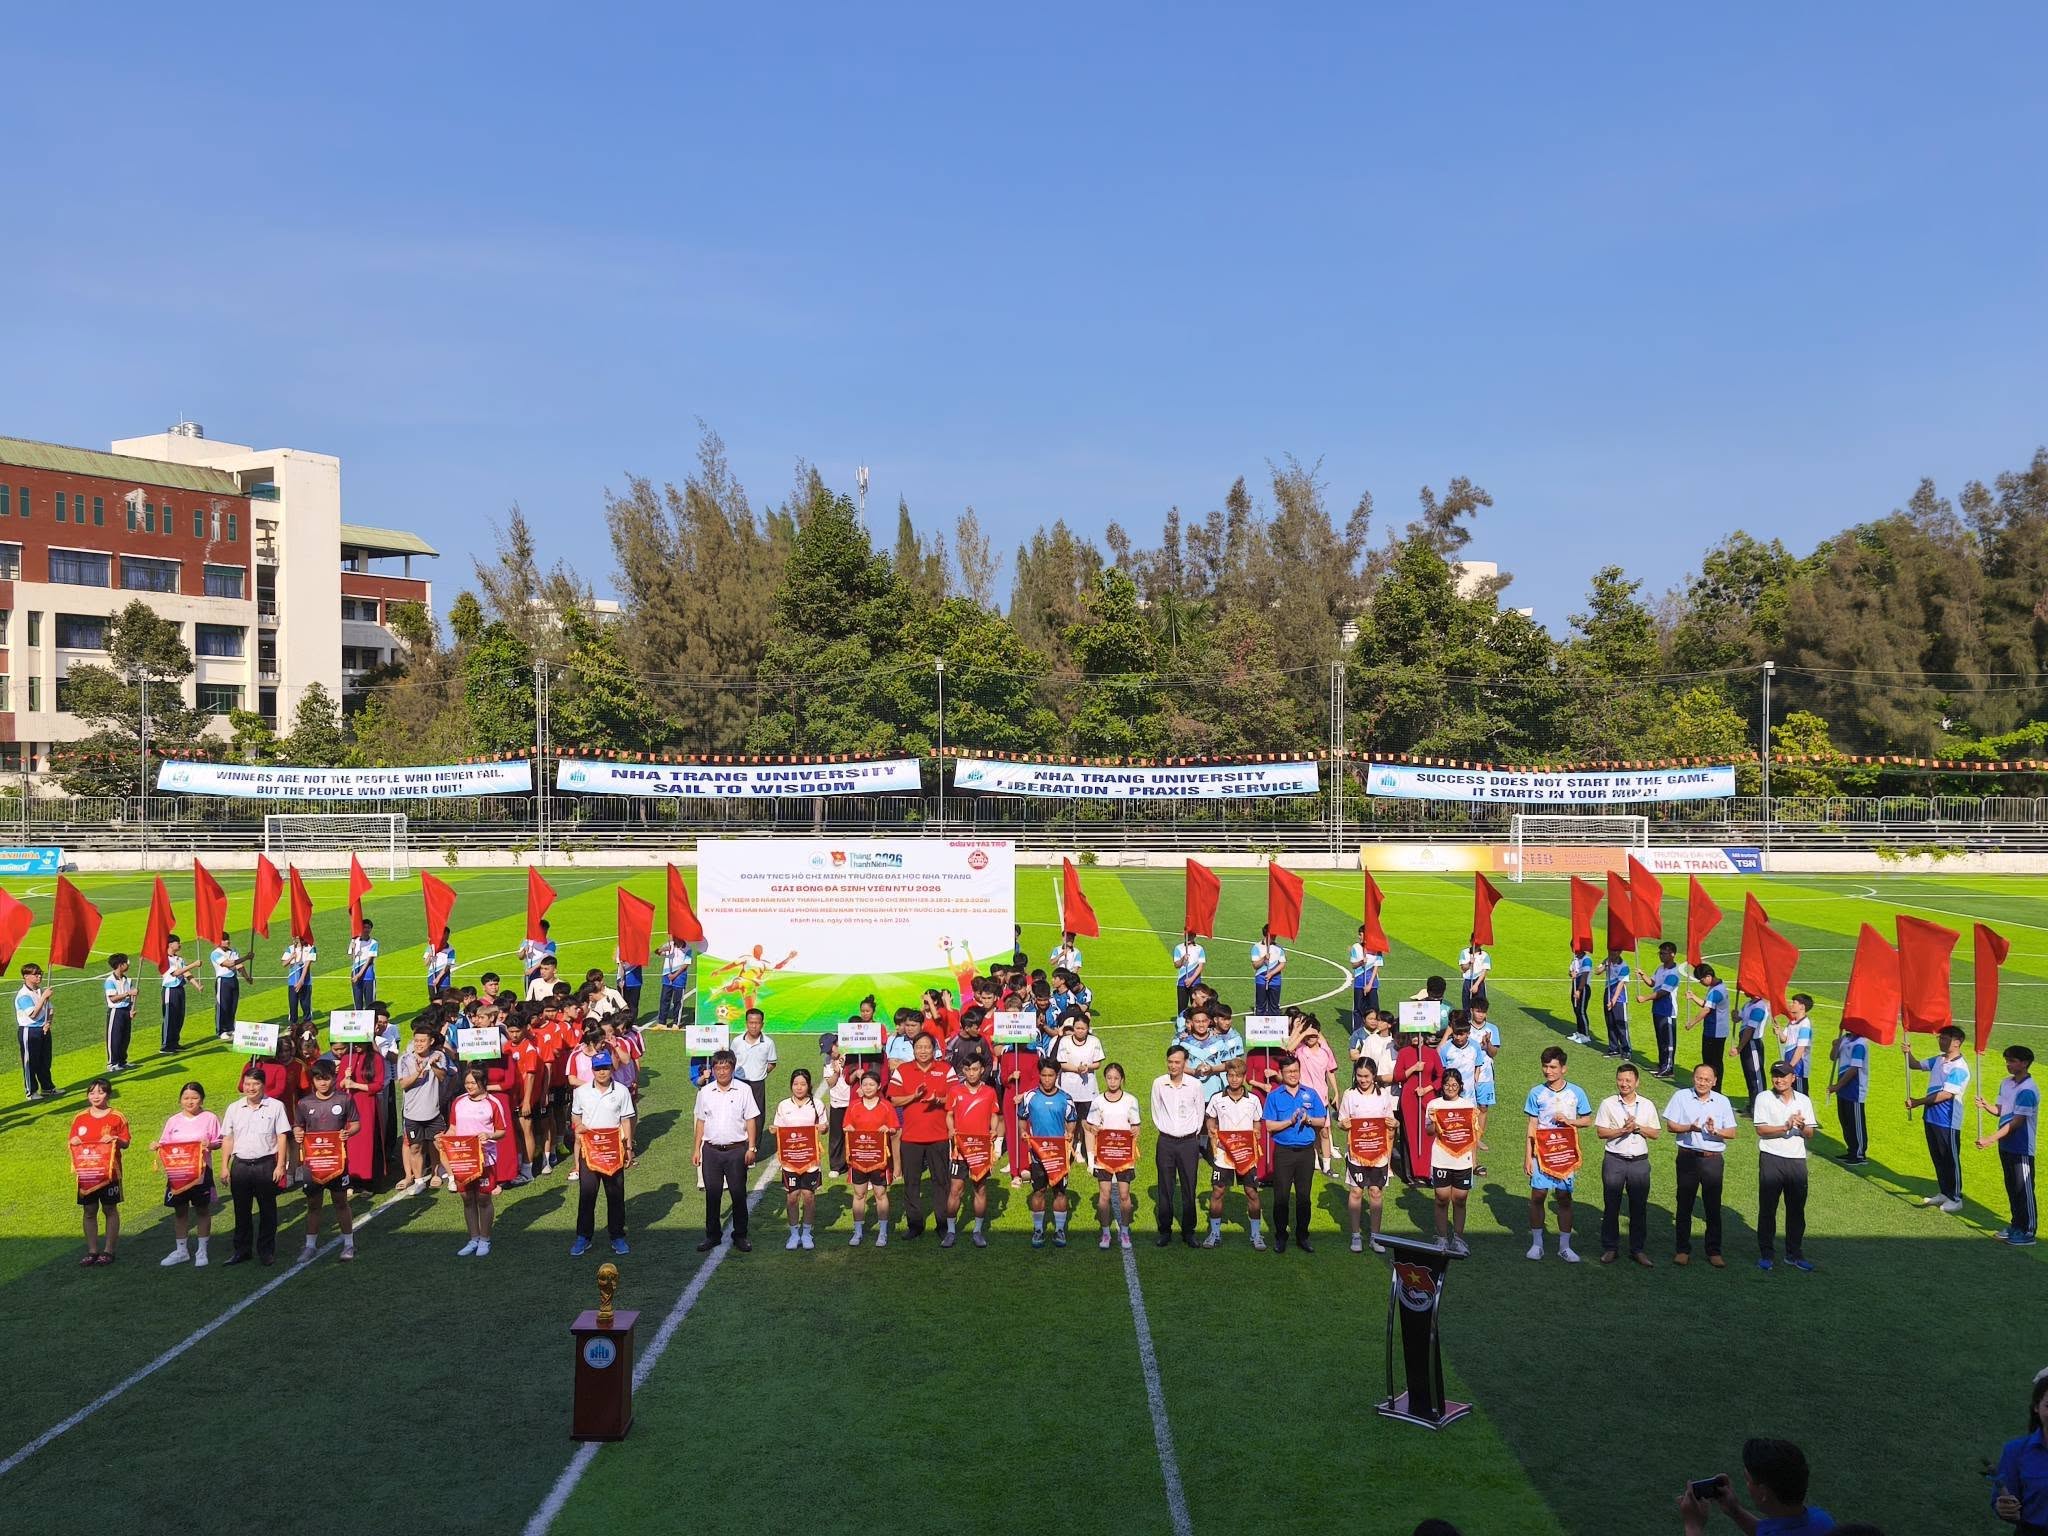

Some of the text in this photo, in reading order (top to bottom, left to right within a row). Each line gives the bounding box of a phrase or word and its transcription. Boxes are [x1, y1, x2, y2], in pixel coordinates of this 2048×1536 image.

[216, 770, 272, 782] WINNERS
[276, 775, 300, 783] ARE
[356, 775, 399, 784] PEOPLE
[404, 773, 431, 782] WHO
[435, 771, 474, 781] NEVER
[612, 766, 896, 782] NHA TRANG UNIVERSITY
[1034, 771, 1266, 783] NHA TRANG UNIVERSITY
[1417, 773, 1485, 784] SUCCESS
[1490, 777, 1528, 786] DOES
[1534, 778, 1562, 787] NOT
[1567, 778, 1610, 786] START
[1616, 778, 1630, 786] IN
[1636, 776, 1662, 785] THE
[257, 784, 462, 796] BUT THE PEOPLE WHO NEVER QUIT!
[653, 782, 855, 794] SAIL TO WISDOM
[997, 780, 1108, 794] LIBERATION
[1129, 786, 1200, 795] PRAXIS
[1221, 781, 1303, 794] SERVICE
[1472, 788, 1486, 796] IT
[1490, 789, 1543, 798] STARTS
[1570, 790, 1606, 798] YOUR
[1654, 860, 1728, 869] NHA TRANG
[951, 1163, 958, 1175] 11
[1354, 1173, 1363, 1182] 10
[108, 1186, 119, 1196] 09
